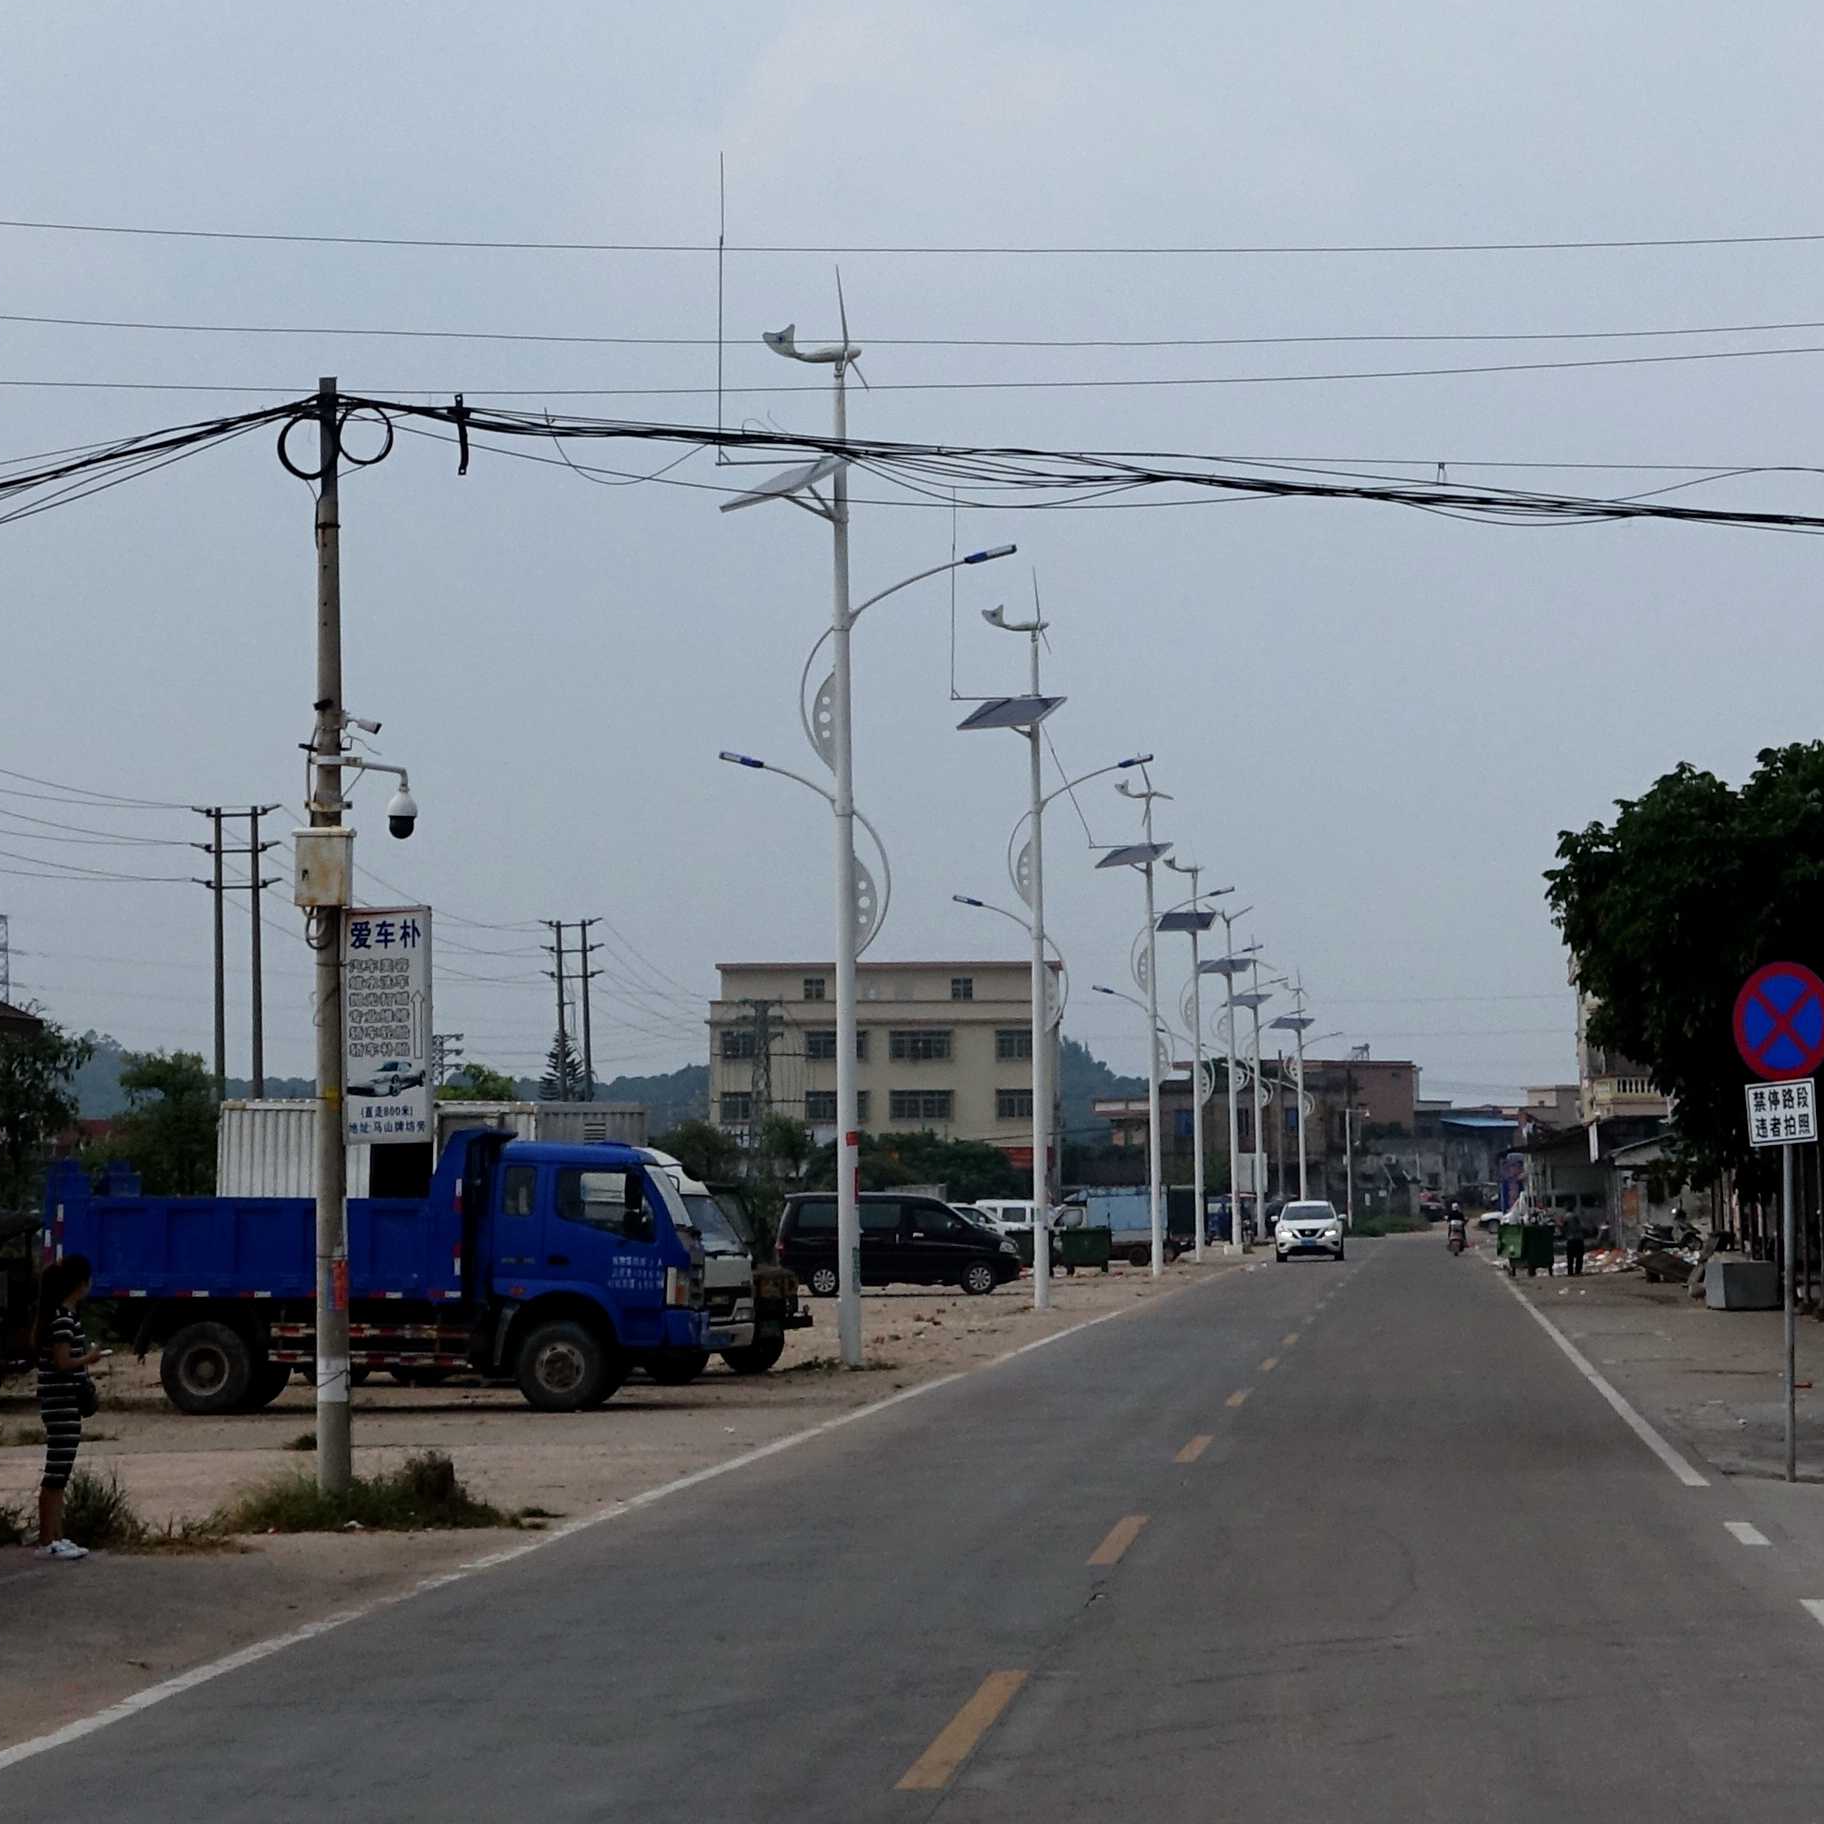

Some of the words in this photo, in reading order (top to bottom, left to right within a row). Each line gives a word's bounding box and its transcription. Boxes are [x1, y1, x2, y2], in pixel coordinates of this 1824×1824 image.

[1752, 1087, 1808, 1112] 禁停路段
[1756, 1114, 1810, 1138] 违者拍照
